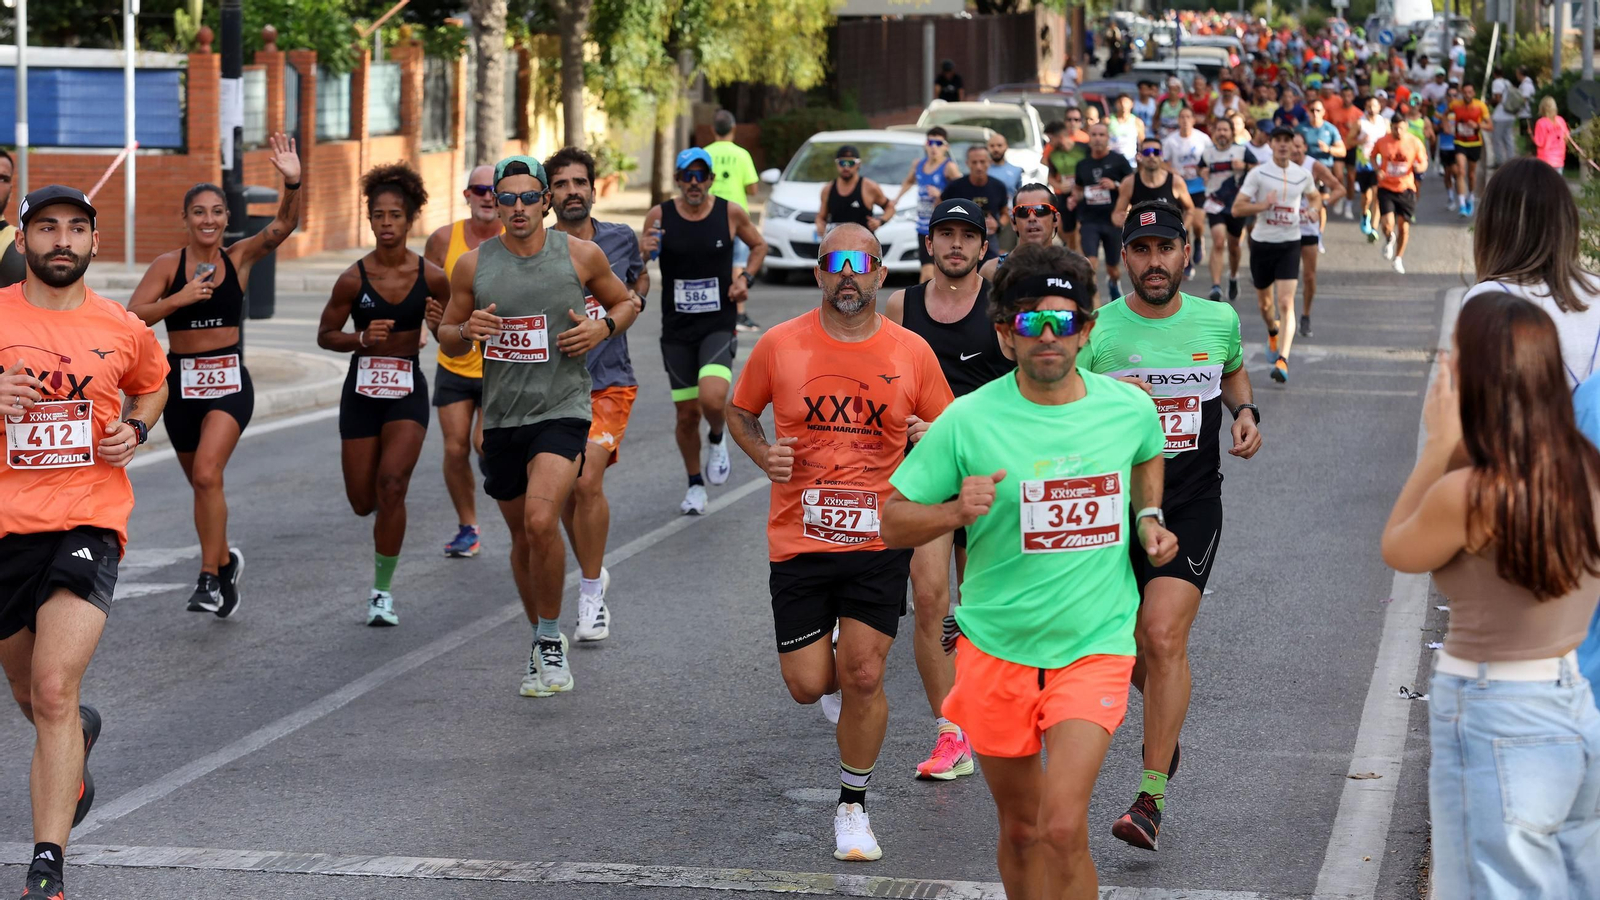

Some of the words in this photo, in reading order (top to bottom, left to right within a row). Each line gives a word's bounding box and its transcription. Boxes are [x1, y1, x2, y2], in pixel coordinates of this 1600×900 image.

[1047, 278, 1072, 289] FILA
[685, 290, 707, 301] 586
[191, 318, 223, 328] ELITE
[500, 333, 531, 347] 486
[197, 371, 226, 384] 263
[371, 371, 399, 384] 254
[803, 395, 888, 428] XXIX
[27, 424, 73, 447] 412
[833, 424, 872, 435] MARATÓN
[821, 509, 861, 529] 527
[1048, 501, 1099, 527] 349
